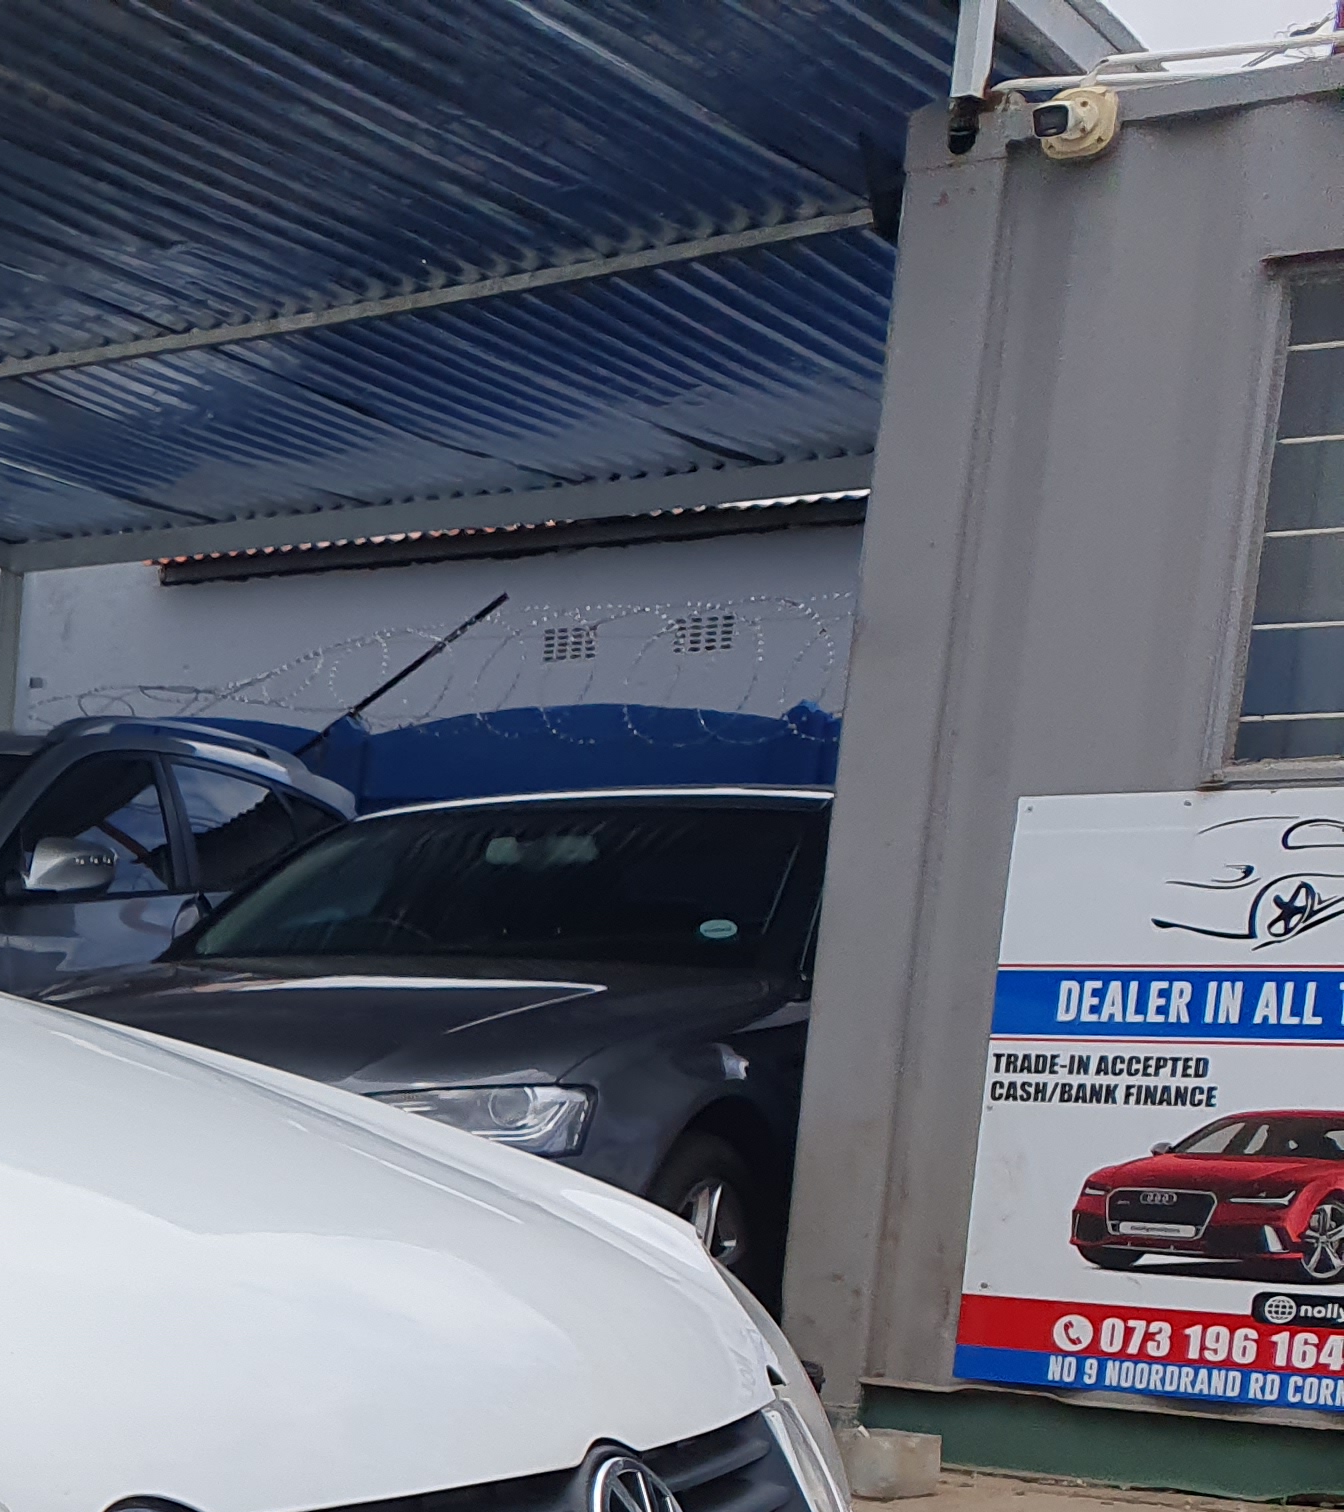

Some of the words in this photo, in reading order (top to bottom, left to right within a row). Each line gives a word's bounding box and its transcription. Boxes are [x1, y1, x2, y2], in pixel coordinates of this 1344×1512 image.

[1056, 980, 1192, 1023] DEALER
[1205, 981, 1244, 1024] IN
[1253, 981, 1323, 1025] ALL
[993, 1053, 1091, 1075] TRADE-IN
[1094, 1055, 1209, 1078] ACCEPTED
[991, 1080, 1119, 1105] CASH/BANK
[1123, 1083, 1218, 1107] FINANCE
[1100, 1318, 1172, 1357] 073
[1184, 1325, 1259, 1364] 196
[1269, 1331, 1344, 1371] 164
[1048, 1355, 1077, 1382] NO
[1083, 1358, 1098, 1384] 9
[1105, 1360, 1242, 1396] NOORDRAND
[1248, 1372, 1281, 1400] RD
